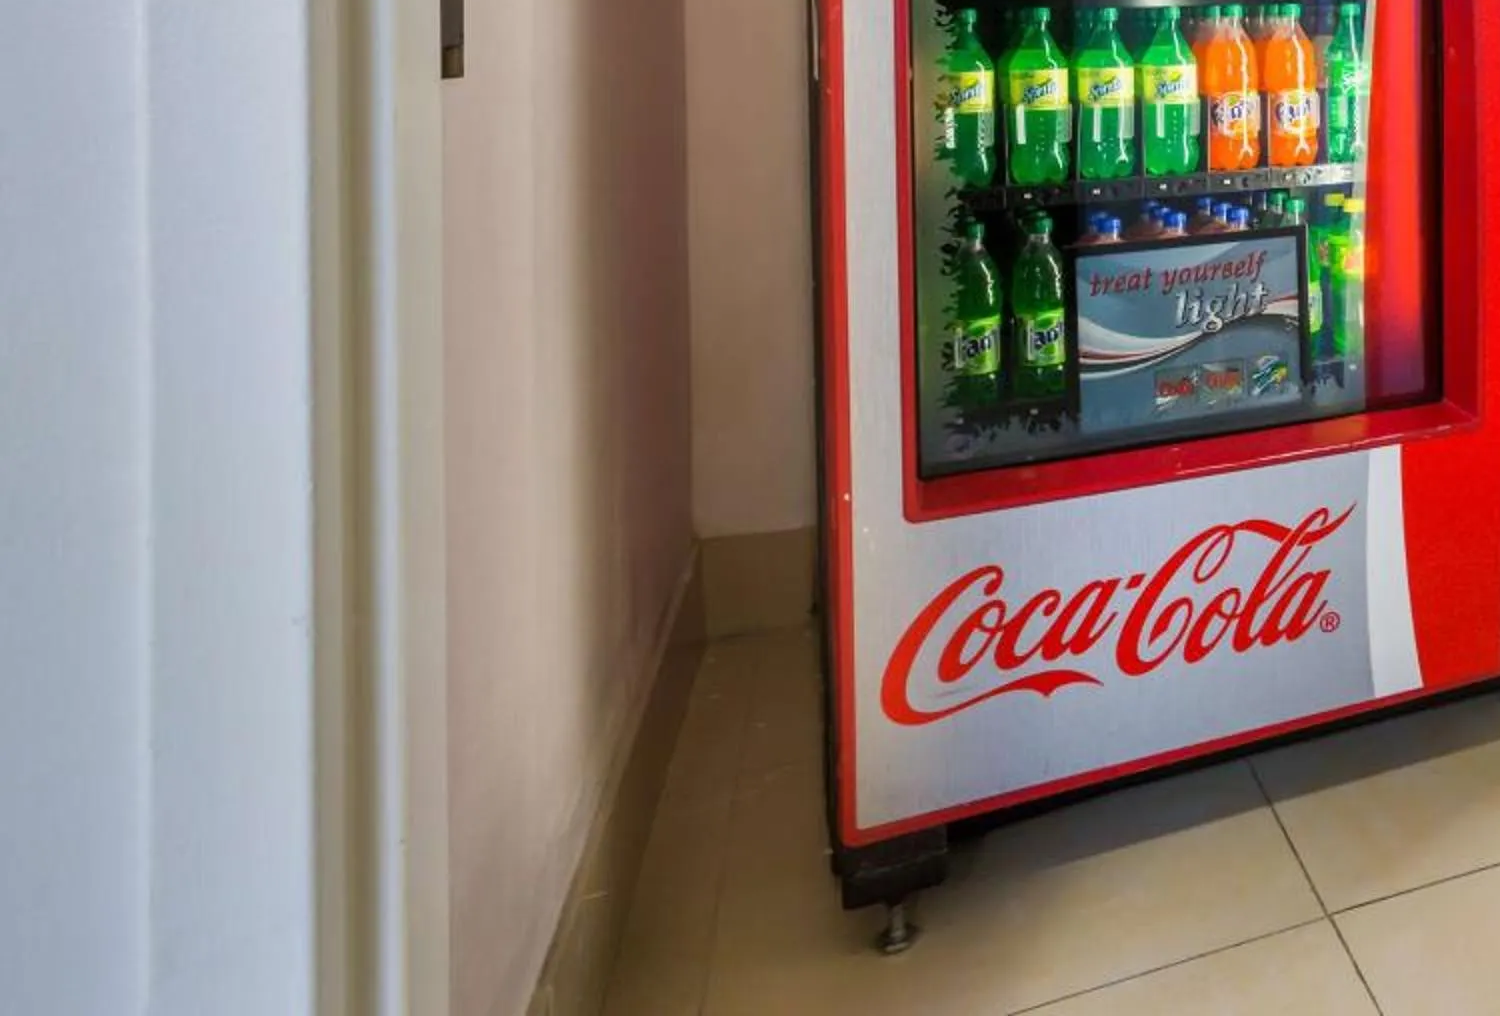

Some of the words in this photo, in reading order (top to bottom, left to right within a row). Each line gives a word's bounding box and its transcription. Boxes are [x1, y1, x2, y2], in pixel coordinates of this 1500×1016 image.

[1090, 267, 1151, 296] treat
[1161, 250, 1267, 295] yourself
[1176, 281, 1268, 333] light
[880, 501, 1357, 726] Coca-Cola
